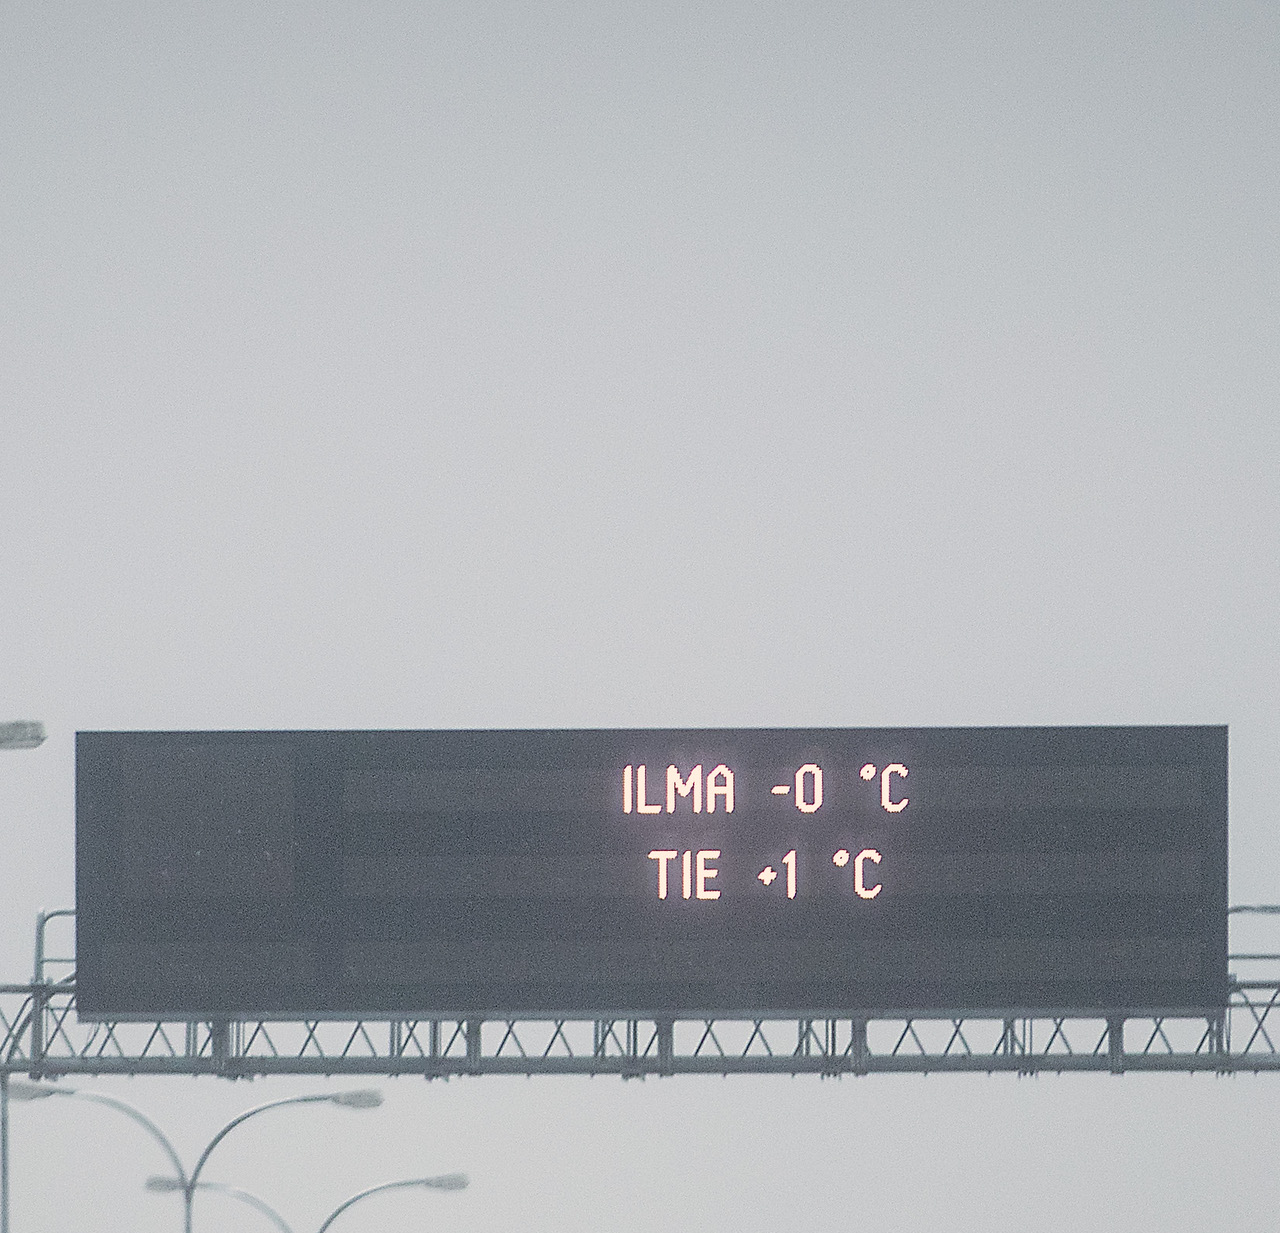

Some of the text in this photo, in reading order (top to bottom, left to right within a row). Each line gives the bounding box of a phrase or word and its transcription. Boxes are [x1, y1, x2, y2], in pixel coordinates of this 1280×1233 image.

[623, 763, 908, 813] ILMA -0 °C
[647, 849, 881, 899] TIE +1 °C
